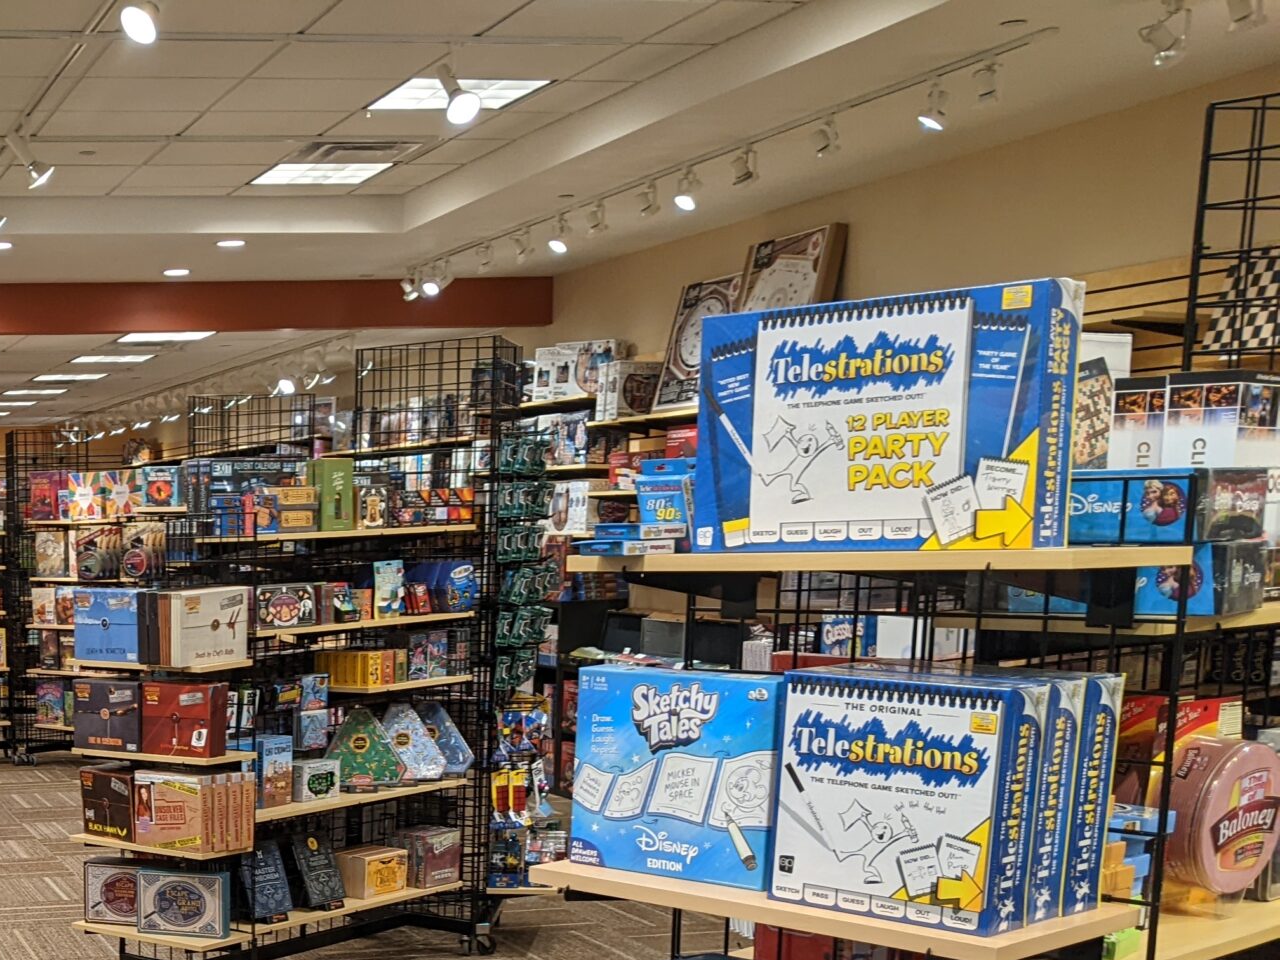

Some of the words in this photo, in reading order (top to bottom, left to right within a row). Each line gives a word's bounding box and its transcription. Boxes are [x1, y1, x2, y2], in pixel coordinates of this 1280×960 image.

[773, 348, 945, 386] Telestrations
[802, 400, 842, 409] TELEPHONE
[865, 394, 903, 404] SKETCHED
[846, 414, 867, 433] 12
[872, 408, 950, 431] PLAYER
[848, 431, 951, 462] PARTY
[1039, 380, 1062, 542] Telestrations
[212, 463, 232, 476] EXIT
[848, 460, 936, 492] PACK
[751, 530, 777, 538] SKETCH
[858, 527, 874, 535] OUT
[631, 682, 719, 720] Sketchy
[844, 702, 866, 712] THE
[869, 704, 923, 717] ORIGINAL
[643, 713, 703, 746] Tales
[795, 726, 980, 776] Telestrations
[667, 768, 696, 781] MICKEY
[664, 778, 691, 792] MOUSE
[691, 777, 700, 788] IN
[810, 776, 825, 784] THE
[827, 778, 869, 790] TELEPHONE
[870, 783, 893, 792] GAME
[894, 786, 936, 798] SKETCHED
[669, 788, 694, 802] SPACE
[1036, 715, 1066, 884] Telestrations
[1075, 712, 1106, 877] Telestrations
[998, 723, 1030, 895] Telestrations
[1217, 806, 1276, 846] Baloney
[571, 840, 584, 848] ALL
[571, 847, 598, 857] DRAWERS
[646, 857, 683, 872] EDITION
[775, 885, 800, 895] SKETCH
[811, 891, 830, 899] PASS
[842, 896, 865, 906] GUESS
[875, 902, 900, 912] LAUGH
[914, 909, 931, 918] OUT
